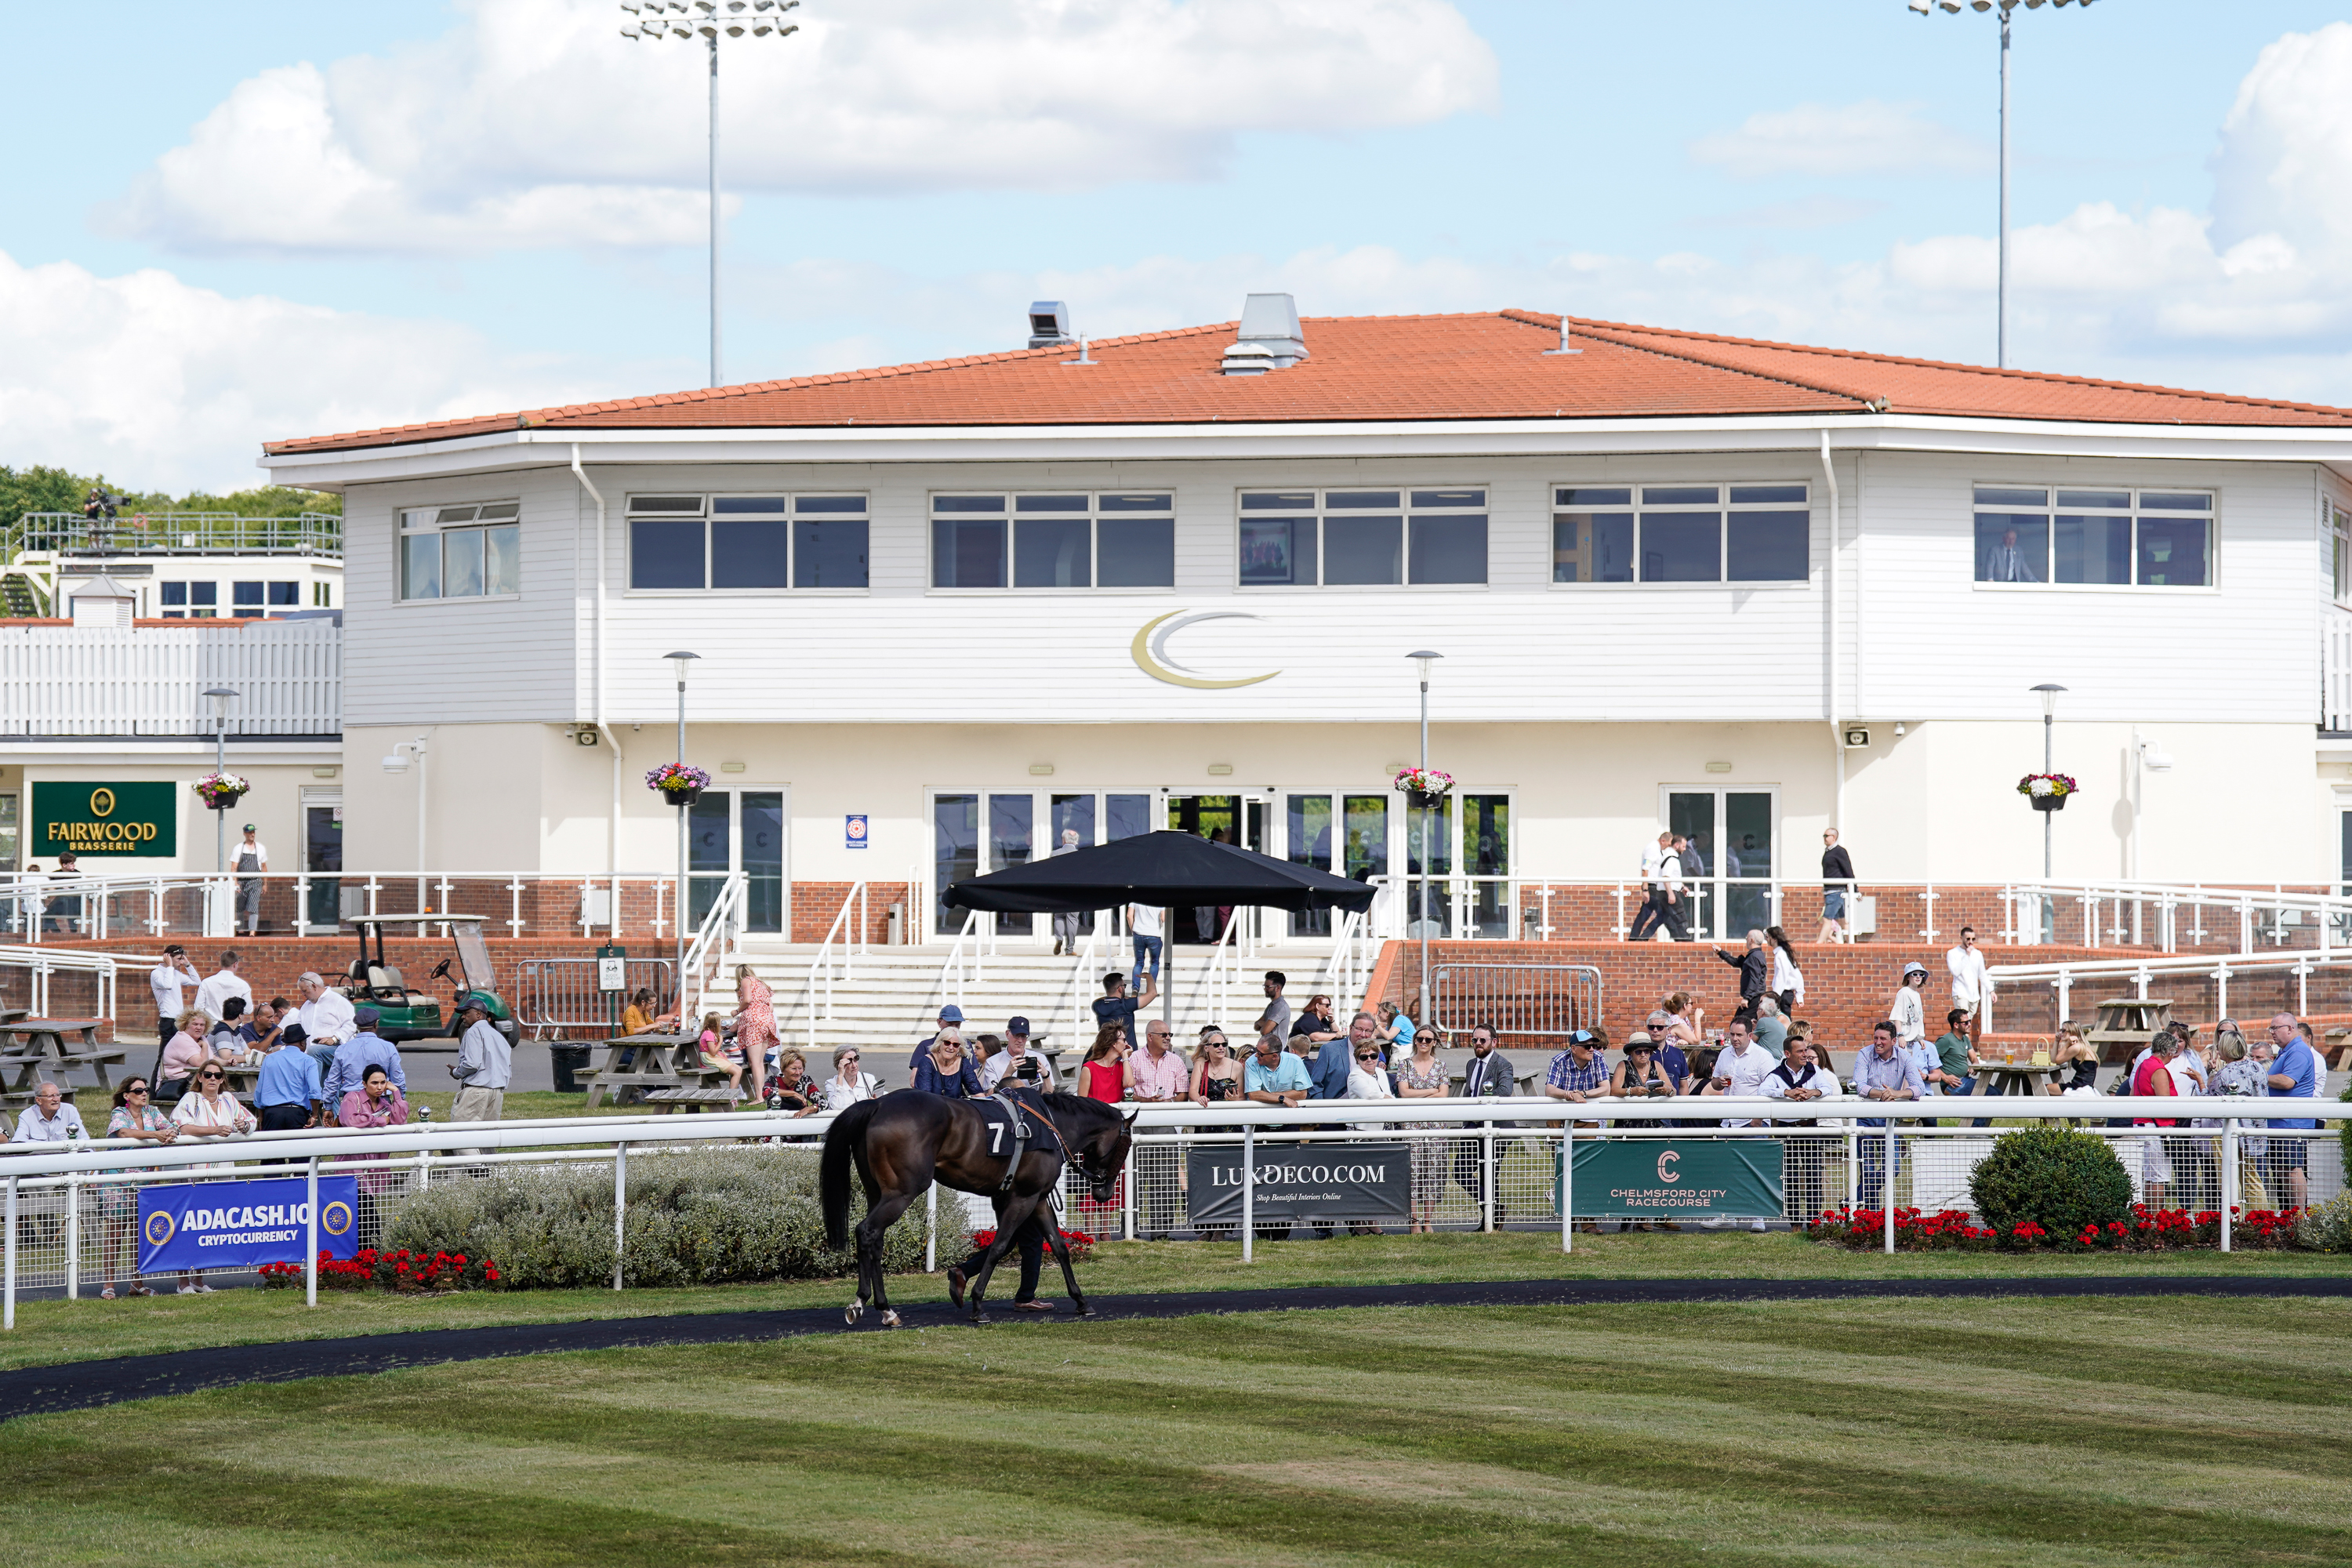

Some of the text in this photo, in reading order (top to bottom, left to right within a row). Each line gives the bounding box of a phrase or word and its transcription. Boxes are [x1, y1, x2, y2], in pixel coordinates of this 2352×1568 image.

[48, 822, 157, 841] FAIRWOOD
[69, 841, 136, 851] BRASSERIE
[988, 1122, 1004, 1153] 7
[1256, 1192, 1341, 1203] Shop Beautiful Interiors Online
[1610, 1189, 1727, 1198] CHELMSFORD CITY
[1626, 1198, 1711, 1207] RACECOURSE
[181, 1203, 309, 1232] ADACASH.IO
[198, 1229, 299, 1247] CRYPTOCURRENCY
